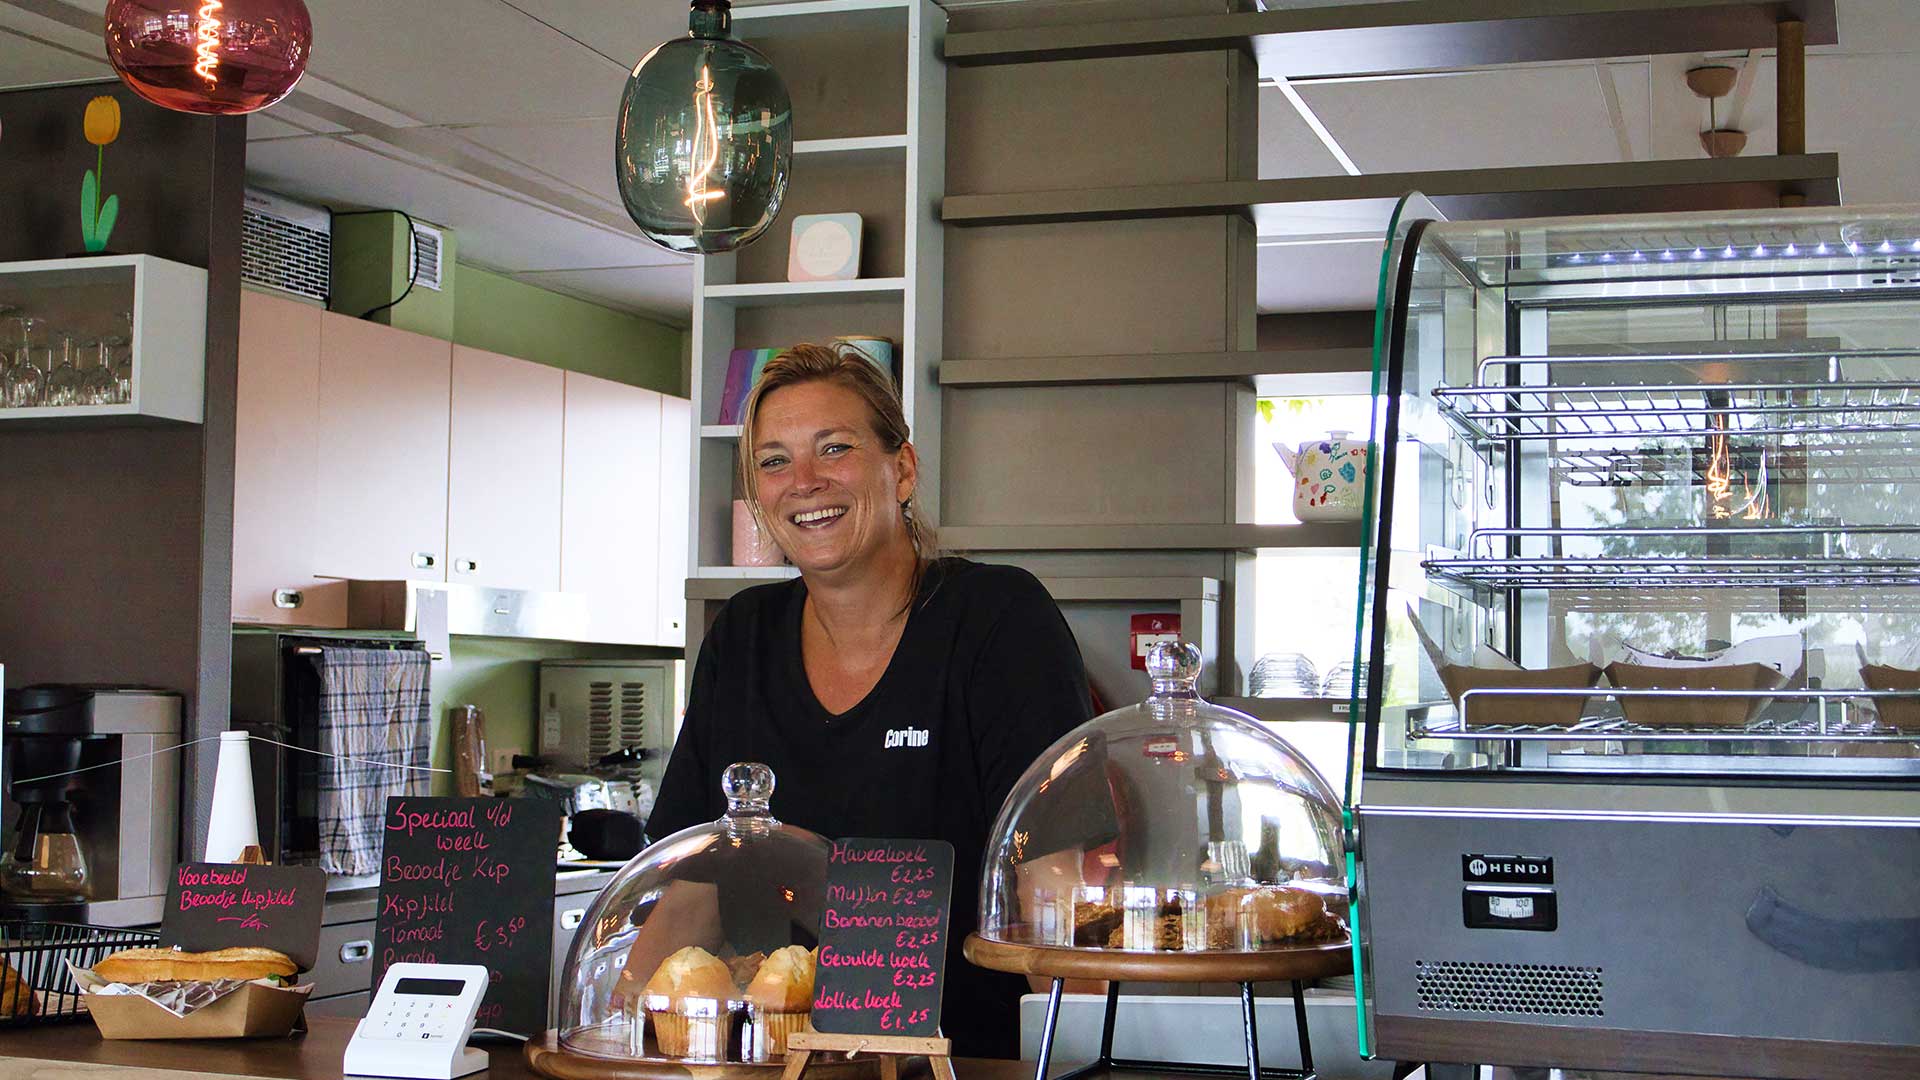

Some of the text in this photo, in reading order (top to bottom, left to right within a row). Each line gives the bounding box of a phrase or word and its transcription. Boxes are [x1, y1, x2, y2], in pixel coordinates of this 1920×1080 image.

[884, 726, 929, 748] Corine
[386, 801, 512, 837] Speciaal v/d
[437, 832, 491, 851] week
[472, 856, 510, 884] Kip
[1490, 863, 1547, 874] HENDI
[826, 885, 887, 910] Muffin
[1515, 899, 1529, 908] 100
[382, 921, 443, 944] Tomaat
[820, 946, 931, 969] Gevulde koek
